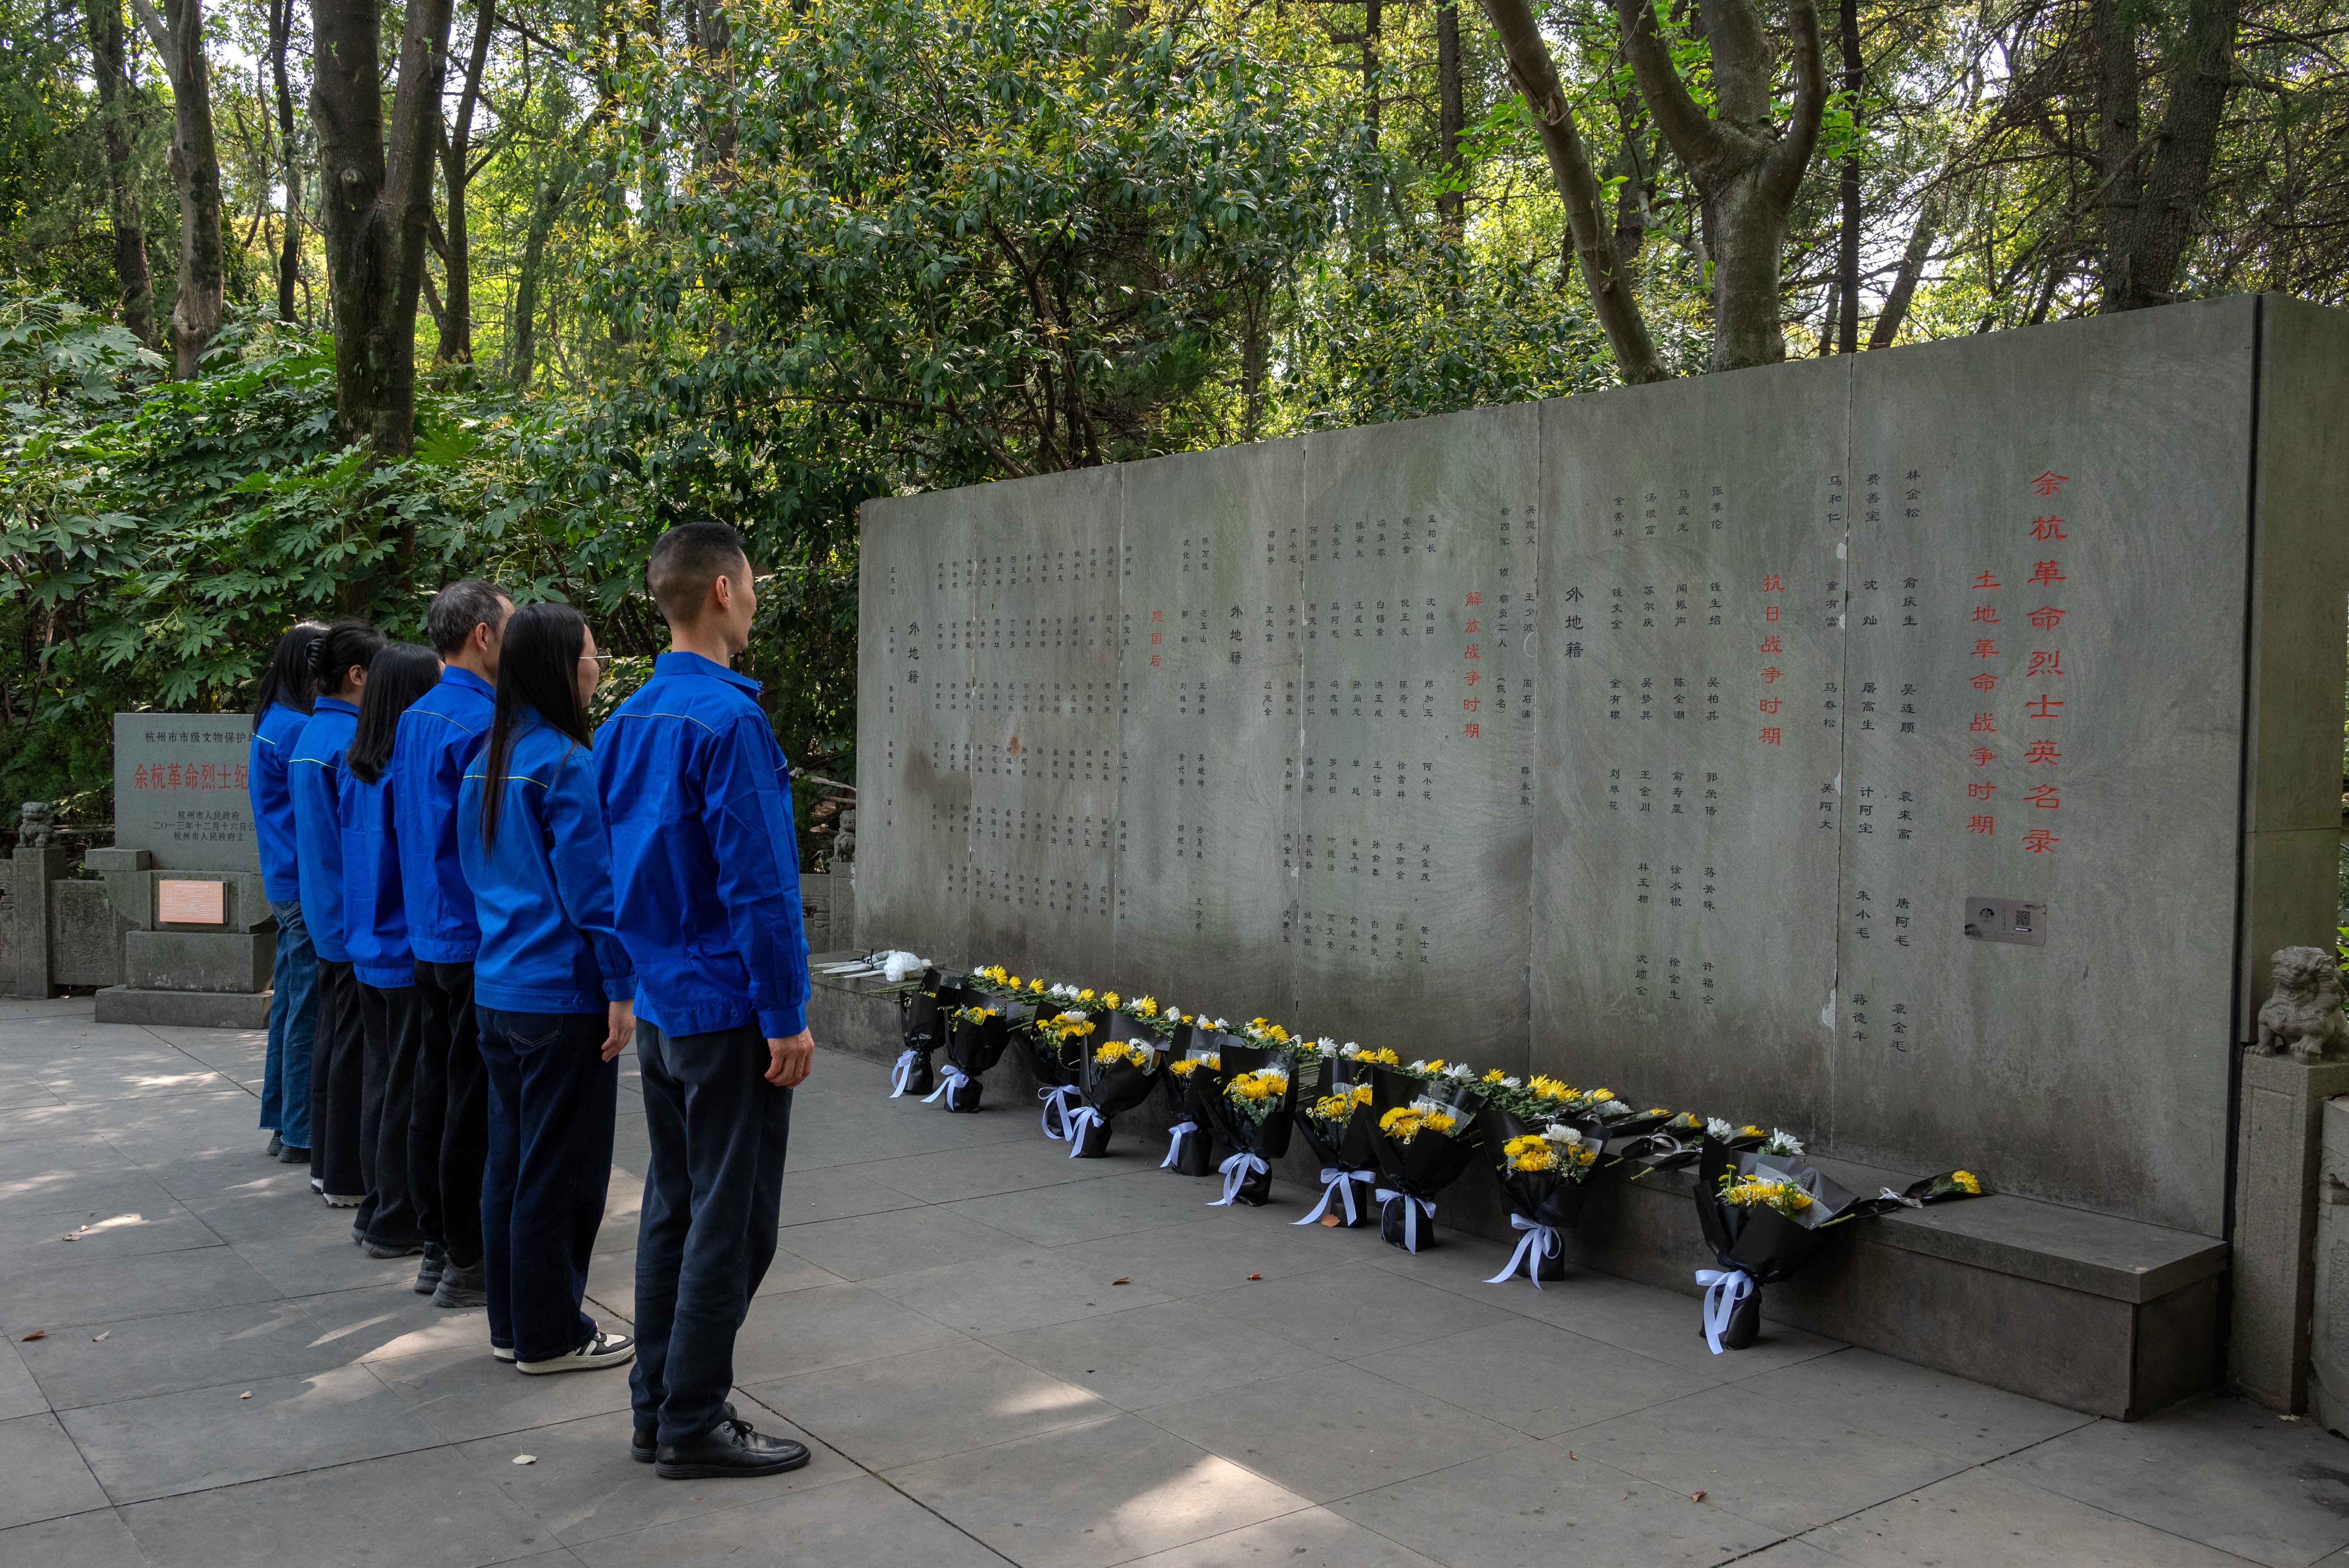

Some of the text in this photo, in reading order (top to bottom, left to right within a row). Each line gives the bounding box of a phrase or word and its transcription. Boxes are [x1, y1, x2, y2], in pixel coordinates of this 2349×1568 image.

[1865, 473, 1880, 522] 费善宝
[1288, 528, 1297, 563] 严小毛
[1309, 526, 1318, 561] 何雨田
[1355, 521, 1365, 558] 陈有生
[1401, 517, 1411, 554] 郑立章
[1427, 514, 1437, 552] 孟柏长
[1262, 530, 1275, 716] 邵骏奇 王定富 应志全
[1287, 604, 1296, 640] 吴余标
[1331, 602, 1340, 638] 马阿毛
[1354, 601, 1363, 637] 汪成友
[1376, 600, 1385, 637] 白锡章
[1400, 599, 1410, 636] 倪正友
[1426, 598, 1436, 634] 沈维田
[1564, 586, 1584, 659] 外地籍
[907, 622, 920, 684] 外地籍
[1150, 609, 1162, 668] 建国后
[1229, 605, 1243, 665] 外地籍
[1609, 497, 1625, 810] 金秀林 钱文金 金有根 刘琴花
[1819, 475, 1842, 829] 马和仁 童有富 马春松 吴阿大
[1463, 592, 1482, 738] 解放战争时期
[1520, 505, 1536, 806] 吴忠义 王少波 周石浦 薛永泉
[1759, 575, 1784, 745] 抗日战争时期
[2022, 470, 2068, 853] 余杭革命烈士英名录
[1285, 681, 1294, 716] 林敬本
[1307, 681, 1315, 716] 高妙仁
[1330, 680, 1339, 716] 冯志明
[1352, 680, 1362, 716] 孙尚志
[1374, 681, 1384, 717] 洪玉成
[1398, 680, 1408, 717] 陈寿毛
[1424, 680, 1433, 717] 郑加玉
[1861, 682, 1877, 731] 屠高生
[1967, 571, 2001, 835] 土地革命战争时期
[1635, 493, 1657, 996] 汤根富 苏尔庆 吴梦其 王金川 林玉相 沈顺金
[1668, 489, 1690, 1000] 马武龙 闻振声 陈金潮 俞寿星 徐水根 徐金生
[1702, 486, 1723, 1005] 张季伦 钱生绍 吴柏其 郭荣倍 蒋关珠 许福全
[1890, 469, 1921, 1052] 林金松 俞庆生 吴连顺 袁来高 唐阿毛 袁金毛
[134, 762, 249, 791] 余杭革命烈士纪
[1328, 758, 1337, 794] 罗荣根
[1351, 759, 1360, 796] 单越
[1372, 761, 1382, 797] 王仕法
[1397, 761, 1406, 799] 徐雪林
[1422, 762, 1433, 800] 何小花
[178, 811, 240, 820] 杭州市人民政府
[1857, 786, 1874, 834] 计阿宝
[174, 831, 244, 841] 杭州市人民政府立
[1283, 833, 1292, 868] 洪金良
[1327, 836, 1336, 871] 叶德法
[1420, 844, 1431, 882] 郑金茂
[1855, 890, 1871, 939] 朱小毛
[1371, 919, 1379, 957] 白希荣
[1395, 923, 1404, 960] 郑学忠
[1852, 994, 1868, 1042] 蒋德年
